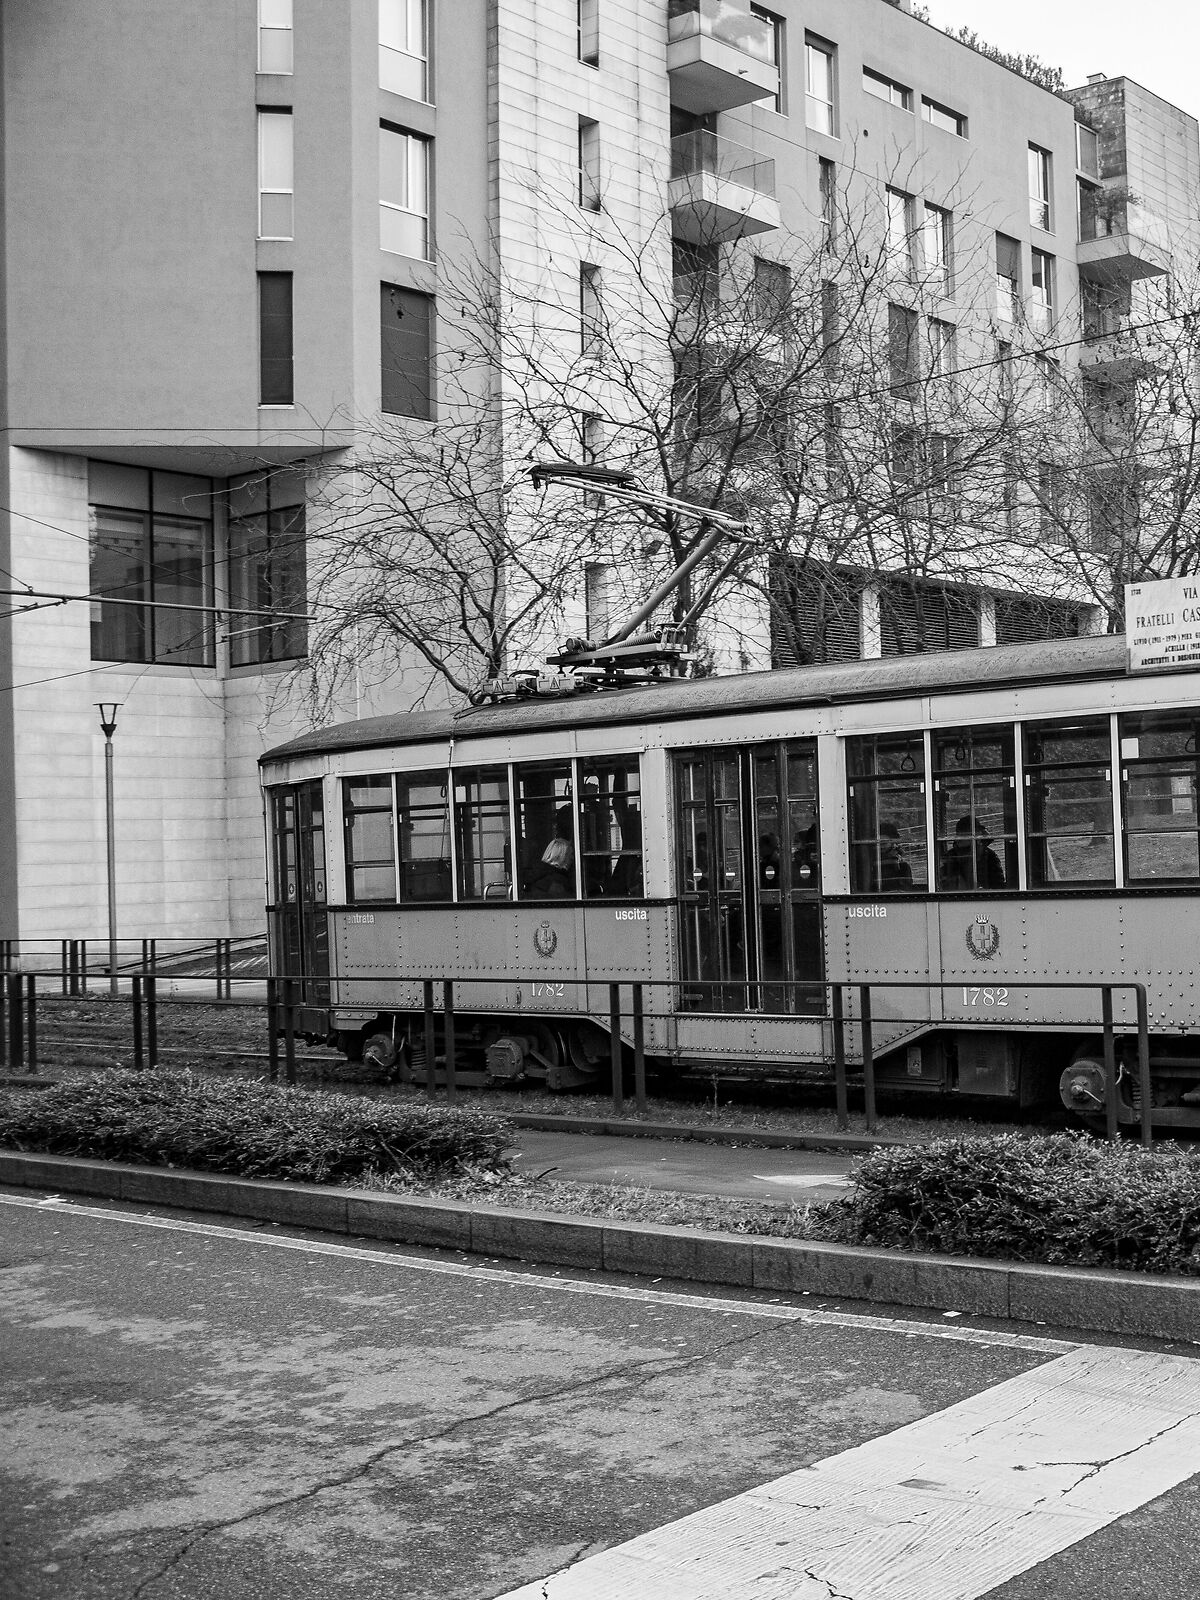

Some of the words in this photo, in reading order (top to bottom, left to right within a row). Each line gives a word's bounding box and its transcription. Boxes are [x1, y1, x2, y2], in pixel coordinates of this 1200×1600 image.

[1183, 587, 1198, 599] VIA
[1136, 613, 1174, 628] FRATELLI
[1165, 644, 1185, 652] ACHILLE
[1141, 656, 1169, 665] ARCHITETTI
[1178, 653, 1200, 661] DESIGNER
[615, 908, 647, 920] uscita
[848, 904, 887, 918] uscita
[531, 983, 564, 997] 1782
[962, 987, 1009, 1007] 1782
